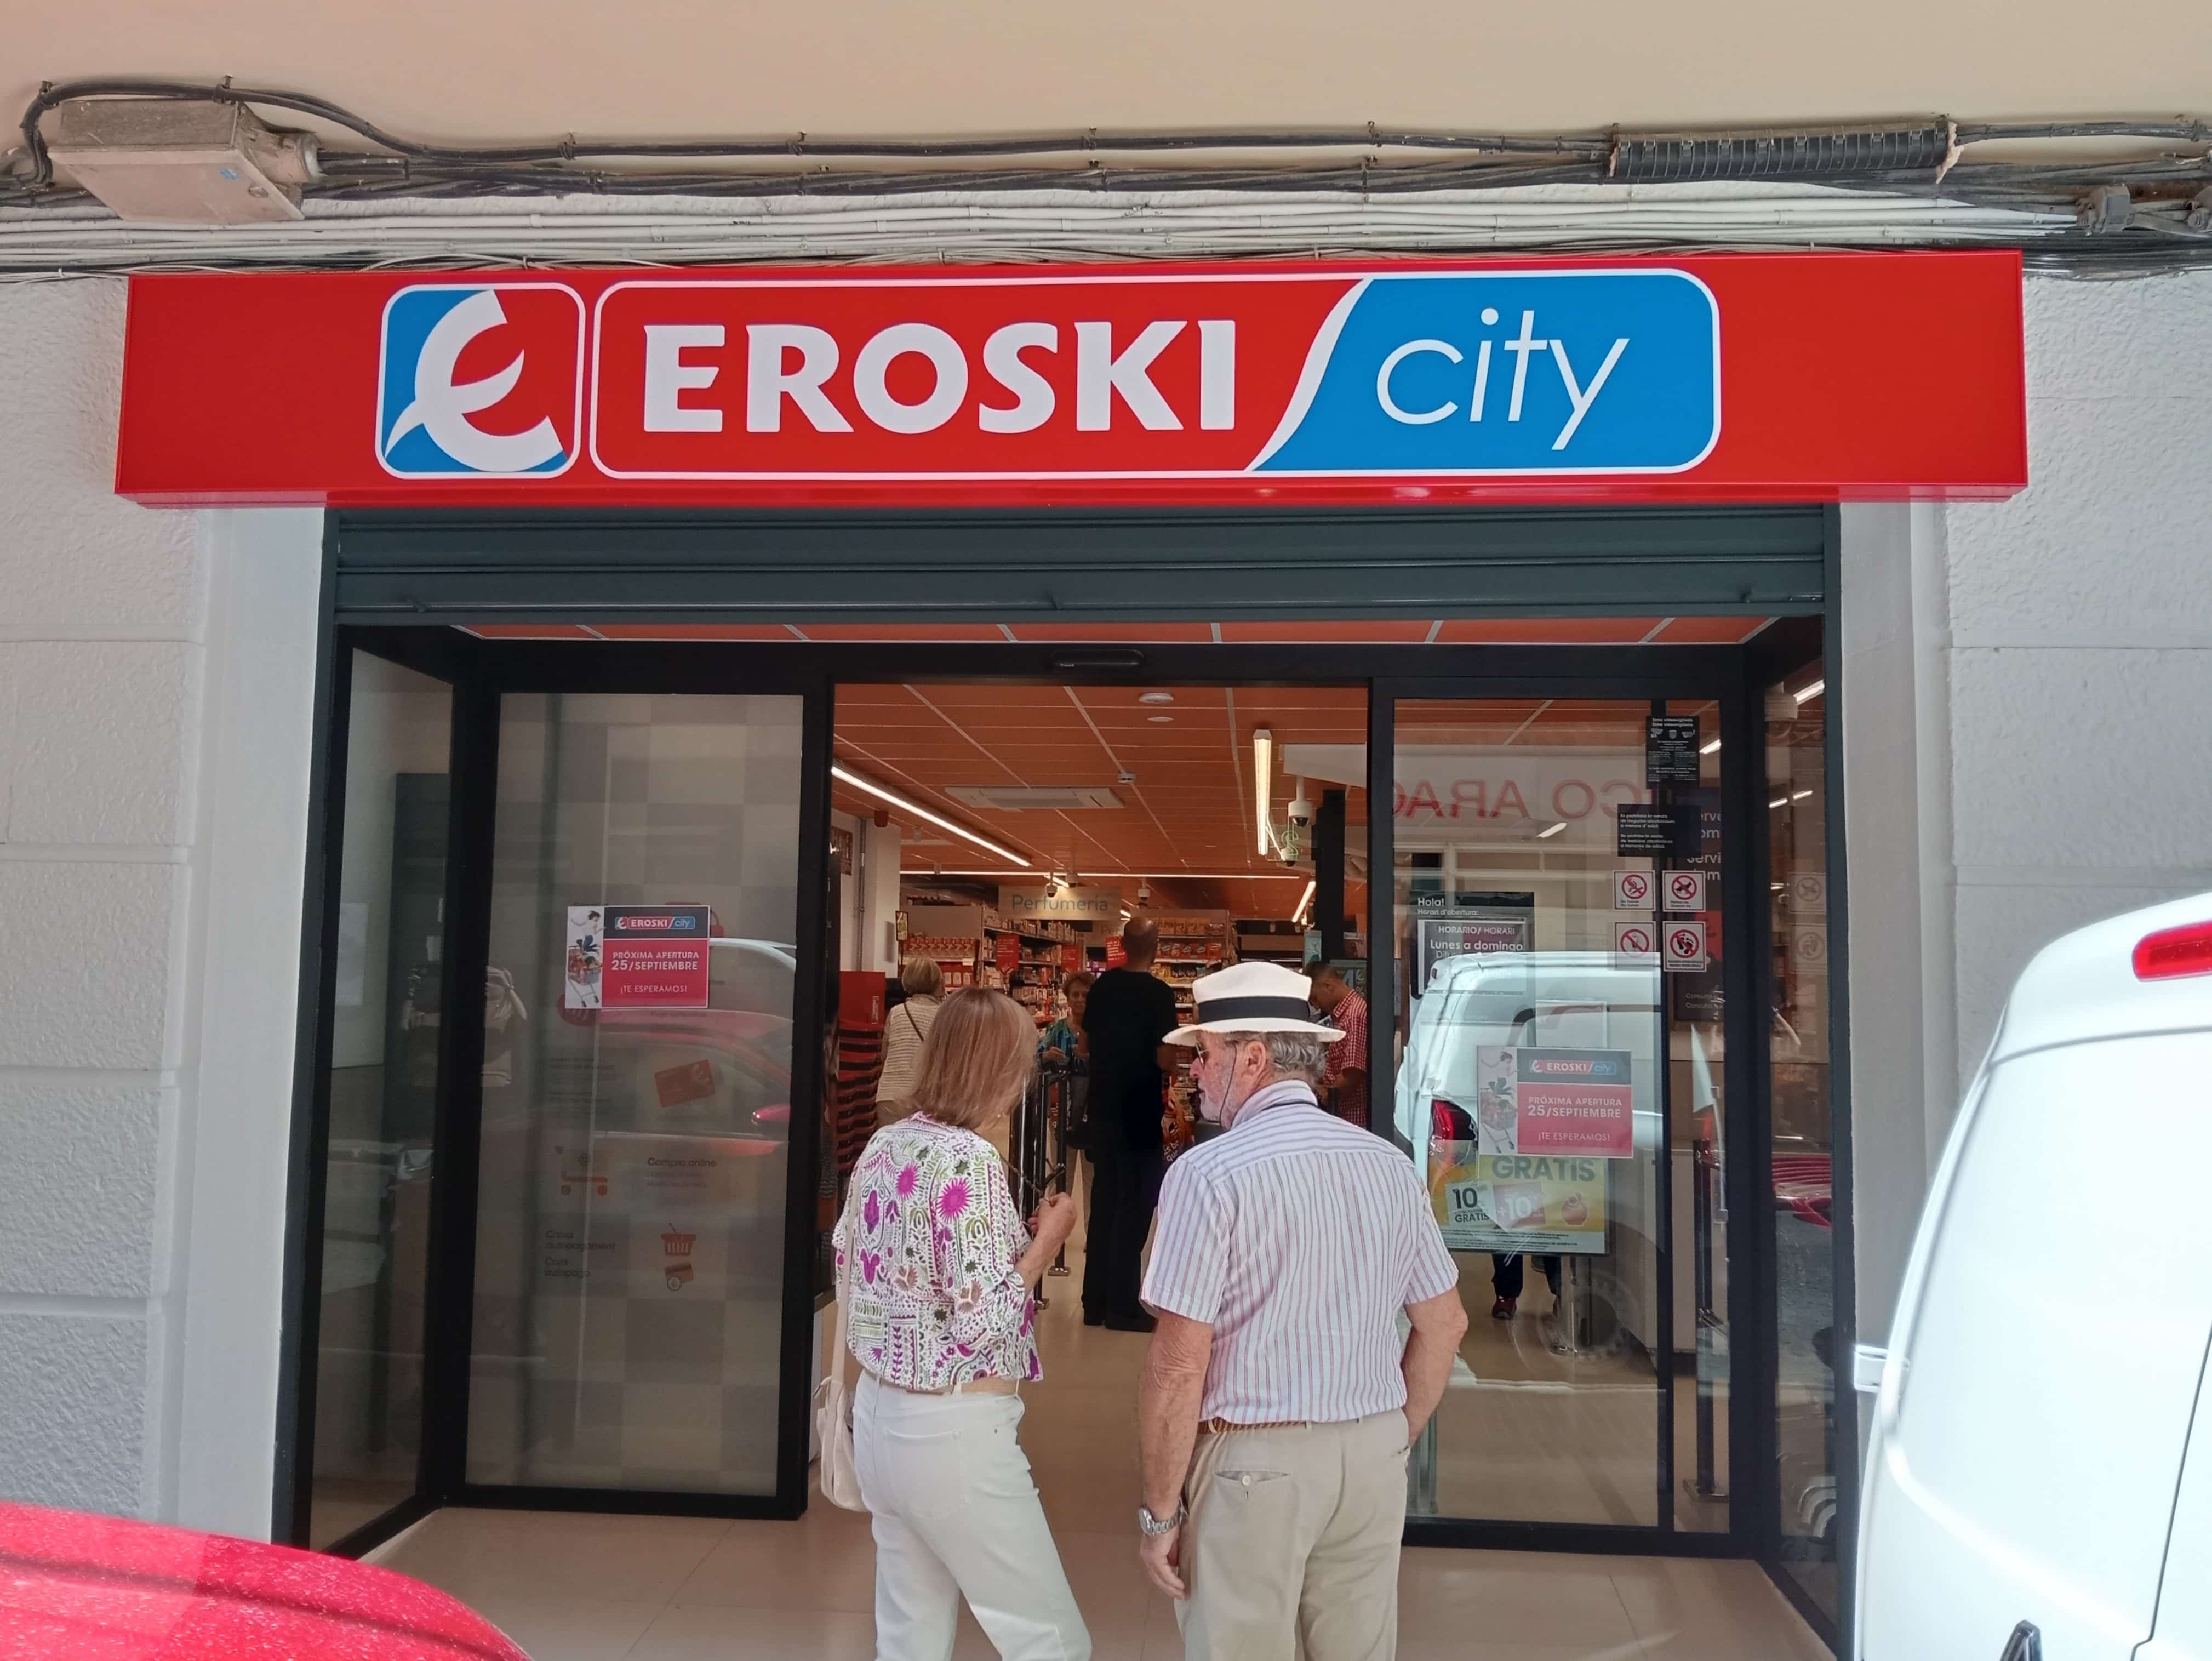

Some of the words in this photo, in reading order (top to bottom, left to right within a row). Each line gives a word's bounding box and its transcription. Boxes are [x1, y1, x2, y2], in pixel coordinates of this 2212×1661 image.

[644, 319, 1236, 434] EROSKI
[1375, 307, 1631, 451] city
[1012, 894, 1108, 911] Perfumería
[1417, 898, 1445, 907] Hola!
[631, 919, 668, 928] EROSKI
[675, 918, 690, 928] city
[1483, 927, 1516, 935] HORARI
[1430, 939, 1460, 949] Lunes
[1474, 940, 1523, 951] domingo
[613, 951, 653, 960] PRÓXIMA
[656, 951, 699, 960] APERTURA
[611, 960, 698, 972] 25/SEPTIEMBRE
[620, 985, 632, 995] ¡TE
[634, 984, 687, 994] ESPERAMOS!
[1546, 1061, 1587, 1072] EROSKI
[1594, 1064, 1610, 1072] city
[1528, 1094, 1572, 1105] PRÓXIMA
[1575, 1098, 1622, 1106] APERTURA
[1527, 1105, 1621, 1118] 25/SEPTIEMBRE
[1538, 1132, 1552, 1142] ¡TE
[1554, 1132, 1610, 1142] ESPERAMOS!
[1492, 1156, 1596, 1182] GRATIS
